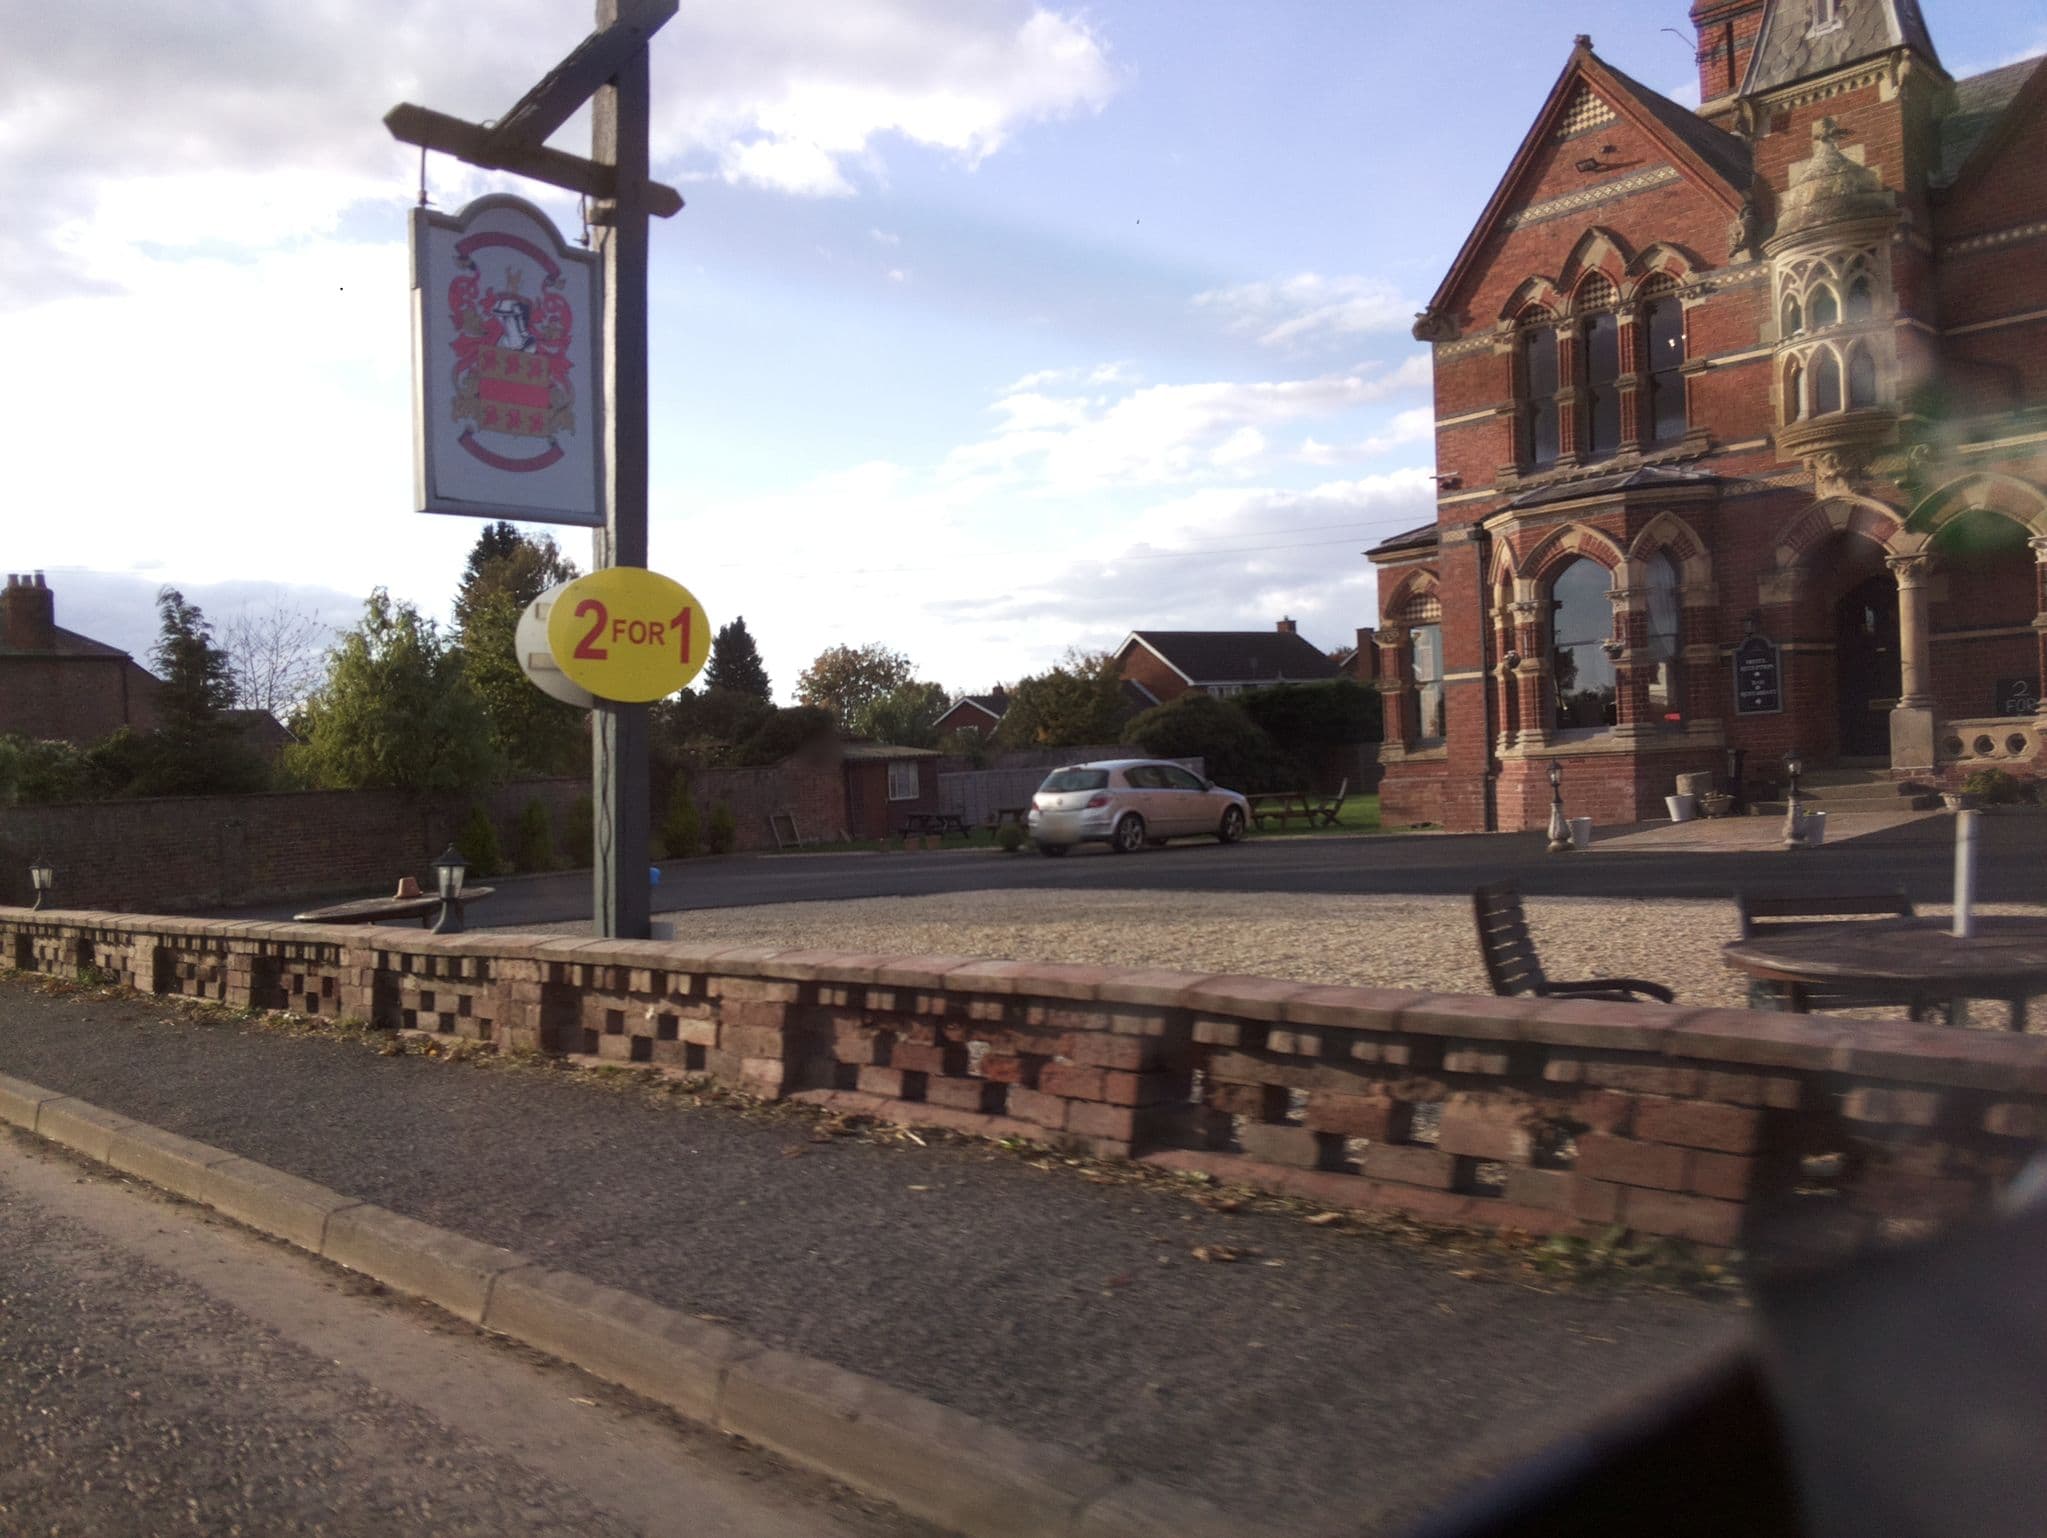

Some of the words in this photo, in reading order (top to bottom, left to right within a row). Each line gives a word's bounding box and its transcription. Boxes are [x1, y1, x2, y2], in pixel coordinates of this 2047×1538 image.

[574, 599, 608, 660] 2
[612, 619, 665, 645] FOR
[671, 607, 691, 664] 1
[2011, 680, 2029, 697] 2
[2006, 698, 2037, 713] FOR
